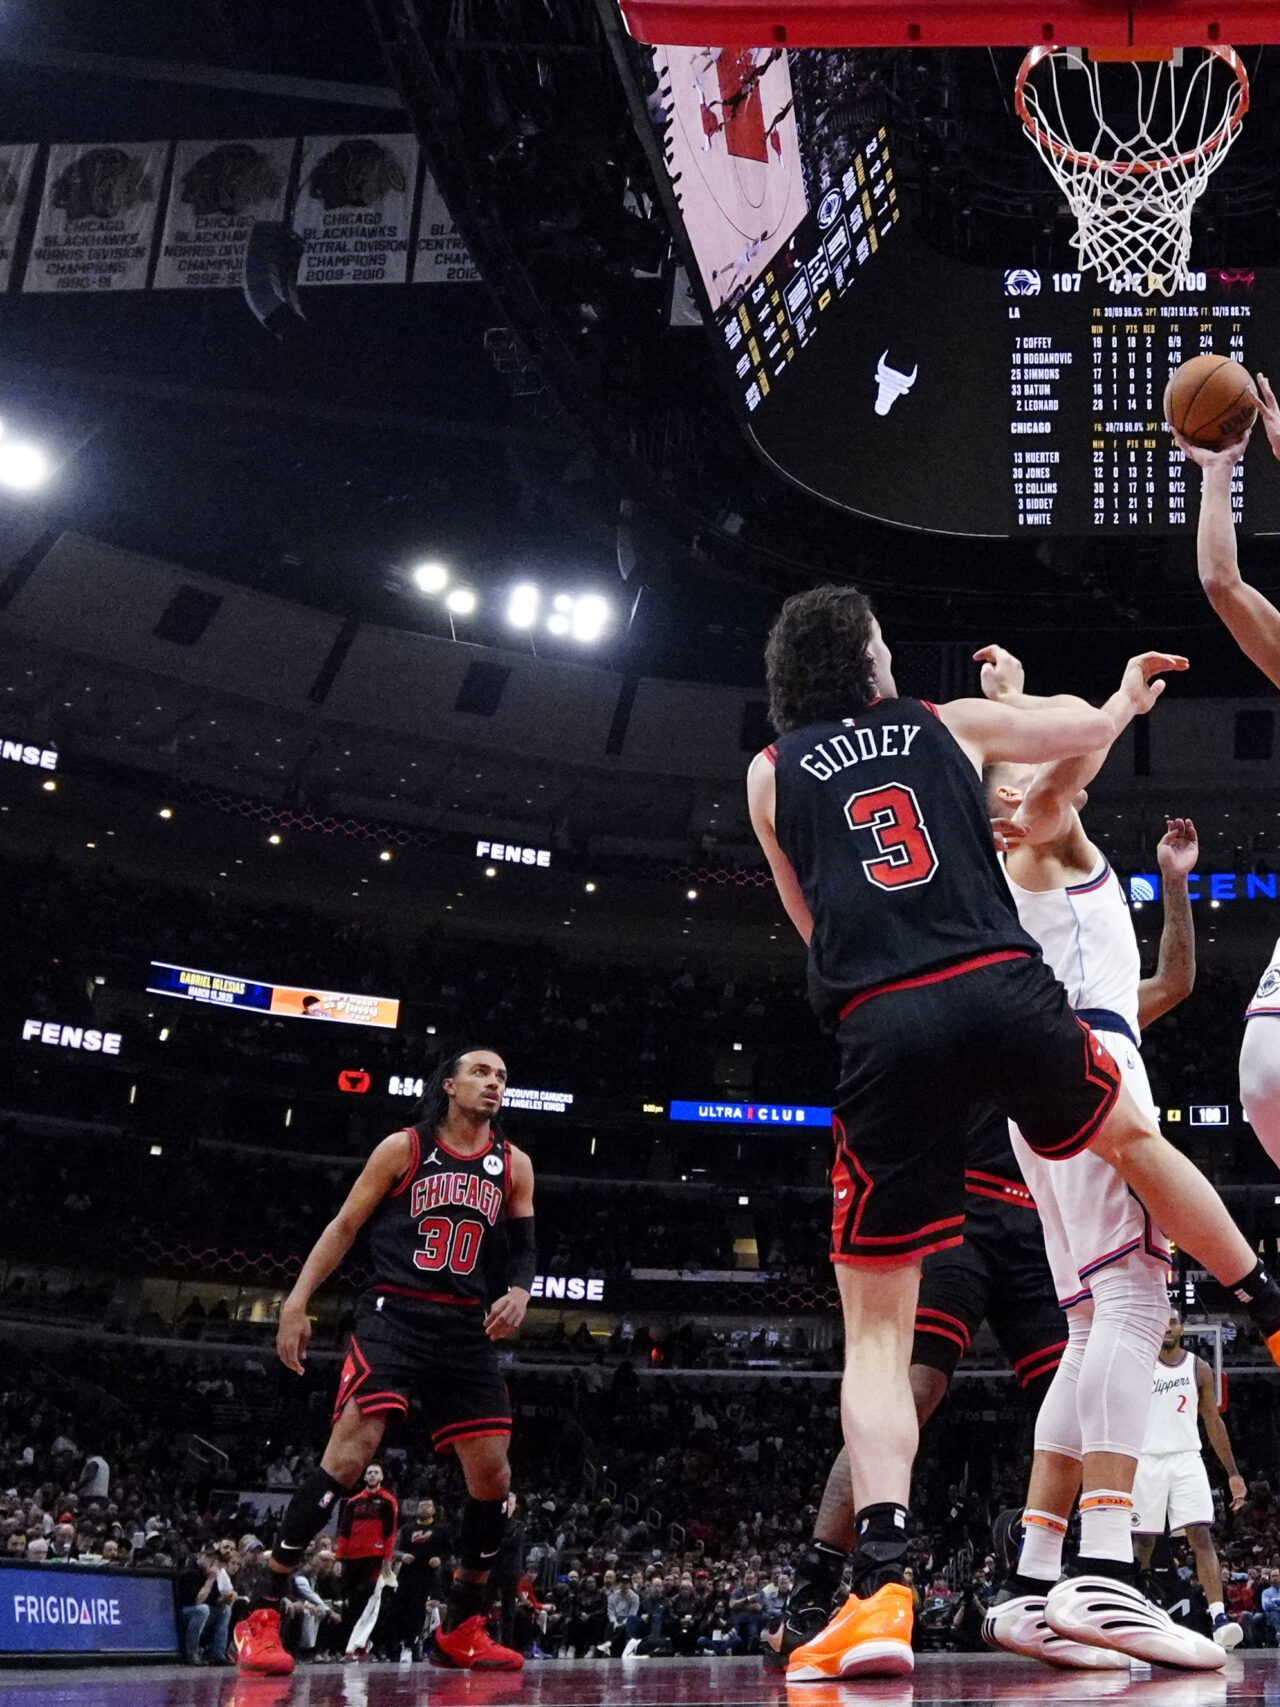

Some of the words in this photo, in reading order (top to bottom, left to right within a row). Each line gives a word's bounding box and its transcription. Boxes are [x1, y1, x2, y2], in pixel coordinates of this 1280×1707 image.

[323, 213, 382, 225] CHICAGO
[303, 226, 397, 240] BLACKHAWKS
[308, 255, 386, 267] CHAMPIONS
[1052, 274, 1082, 292] 107
[1009, 307, 1020, 318] LA
[1126, 325, 1138, 333] PTS
[1016, 337, 1020, 348] 7
[1023, 337, 1052, 348] COFFEY
[1093, 337, 1102, 348] 19
[1127, 336, 1136, 348] 18
[1168, 336, 1181, 347] 6/9
[1200, 335, 1213, 347] 2/4
[1230, 335, 1243, 347] 4/4
[1012, 353, 1021, 364] 10
[1024, 352, 1072, 364] BOGDANOVIC
[1093, 352, 1101, 364] 17
[1128, 352, 1135, 363] 11
[1168, 351, 1181, 363] 4/5
[1011, 368, 1021, 380] 25
[1024, 368, 1060, 380] SIMMONS
[1093, 368, 1102, 379] 17
[1012, 384, 1021, 396] 33
[1024, 384, 1050, 396] BATUM
[1093, 384, 1102, 395] 16
[1016, 400, 1022, 411] 2
[1024, 400, 1058, 411] LEONARD
[1093, 399, 1103, 410] 28
[1128, 399, 1136, 410] 14
[1011, 422, 1051, 434] CHICAGO
[1014, 452, 1022, 463] 13
[1025, 452, 1059, 464] HUERTER
[1093, 452, 1103, 462] 22
[1169, 450, 1184, 462] 3/10
[1013, 468, 1022, 479] 30
[1025, 468, 1050, 479] JONES
[1094, 467, 1103, 478] 12
[1128, 467, 1137, 478] 13
[1169, 466, 1181, 478] 6/7
[1014, 483, 1023, 494] 12
[1026, 483, 1057, 494] COLLINS
[1094, 482, 1104, 493] 30
[1129, 482, 1137, 493] 17
[1146, 482, 1154, 493] 16
[1169, 482, 1185, 493] 6/12
[1018, 498, 1024, 510] 3
[1026, 498, 1053, 509] GIDDEY
[1094, 498, 1104, 508] 29
[1128, 497, 1137, 508] 21
[1169, 496, 1184, 508] 8/11
[1018, 514, 1024, 525] 0
[1026, 513, 1051, 524] WHITE
[1094, 513, 1104, 524] 27
[1129, 512, 1137, 524] 14
[1169, 512, 1185, 524] 5/13
[0, 739, 58, 770] NSE
[800, 725, 921, 781] GIDDEY
[843, 782, 939, 891] 3
[476, 840, 551, 867] FENSE
[180, 971, 212, 988] GABRIEL
[212, 976, 245, 995] IGLESIAS
[22, 1019, 122, 1055] FENSE
[510, 1098, 542, 1110] ANGELES
[543, 1101, 565, 1112] KINGS
[699, 1106, 742, 1118] ULTRA
[758, 1108, 805, 1122] CLUB
[410, 1172, 503, 1226] CHICAGO
[413, 1216, 484, 1276] 30
[1177, 1395, 1187, 1413] 2
[14, 1595, 121, 1625] FRIGIDAIRE
